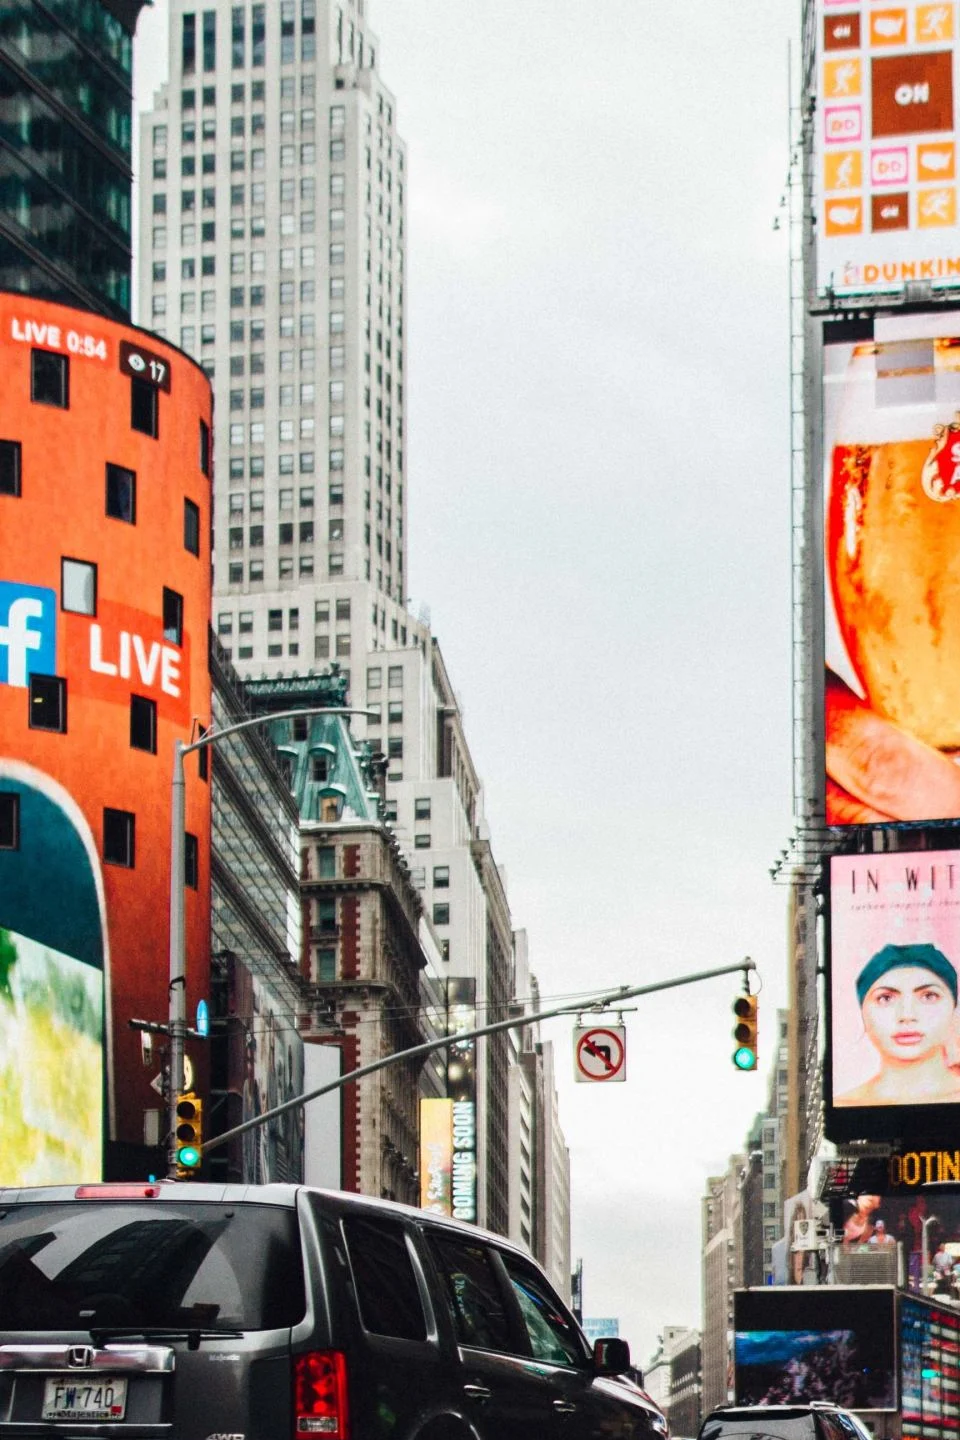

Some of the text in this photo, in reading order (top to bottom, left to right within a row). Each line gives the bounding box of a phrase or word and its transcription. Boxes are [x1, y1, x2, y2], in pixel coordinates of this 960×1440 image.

[895, 82, 929, 106] OH
[11, 318, 107, 360] LIVE 0:54
[149, 361, 166, 383] 17
[89, 623, 181, 698] LIVE
[851, 868, 879, 895] IN
[452, 1101, 476, 1149] SOON
